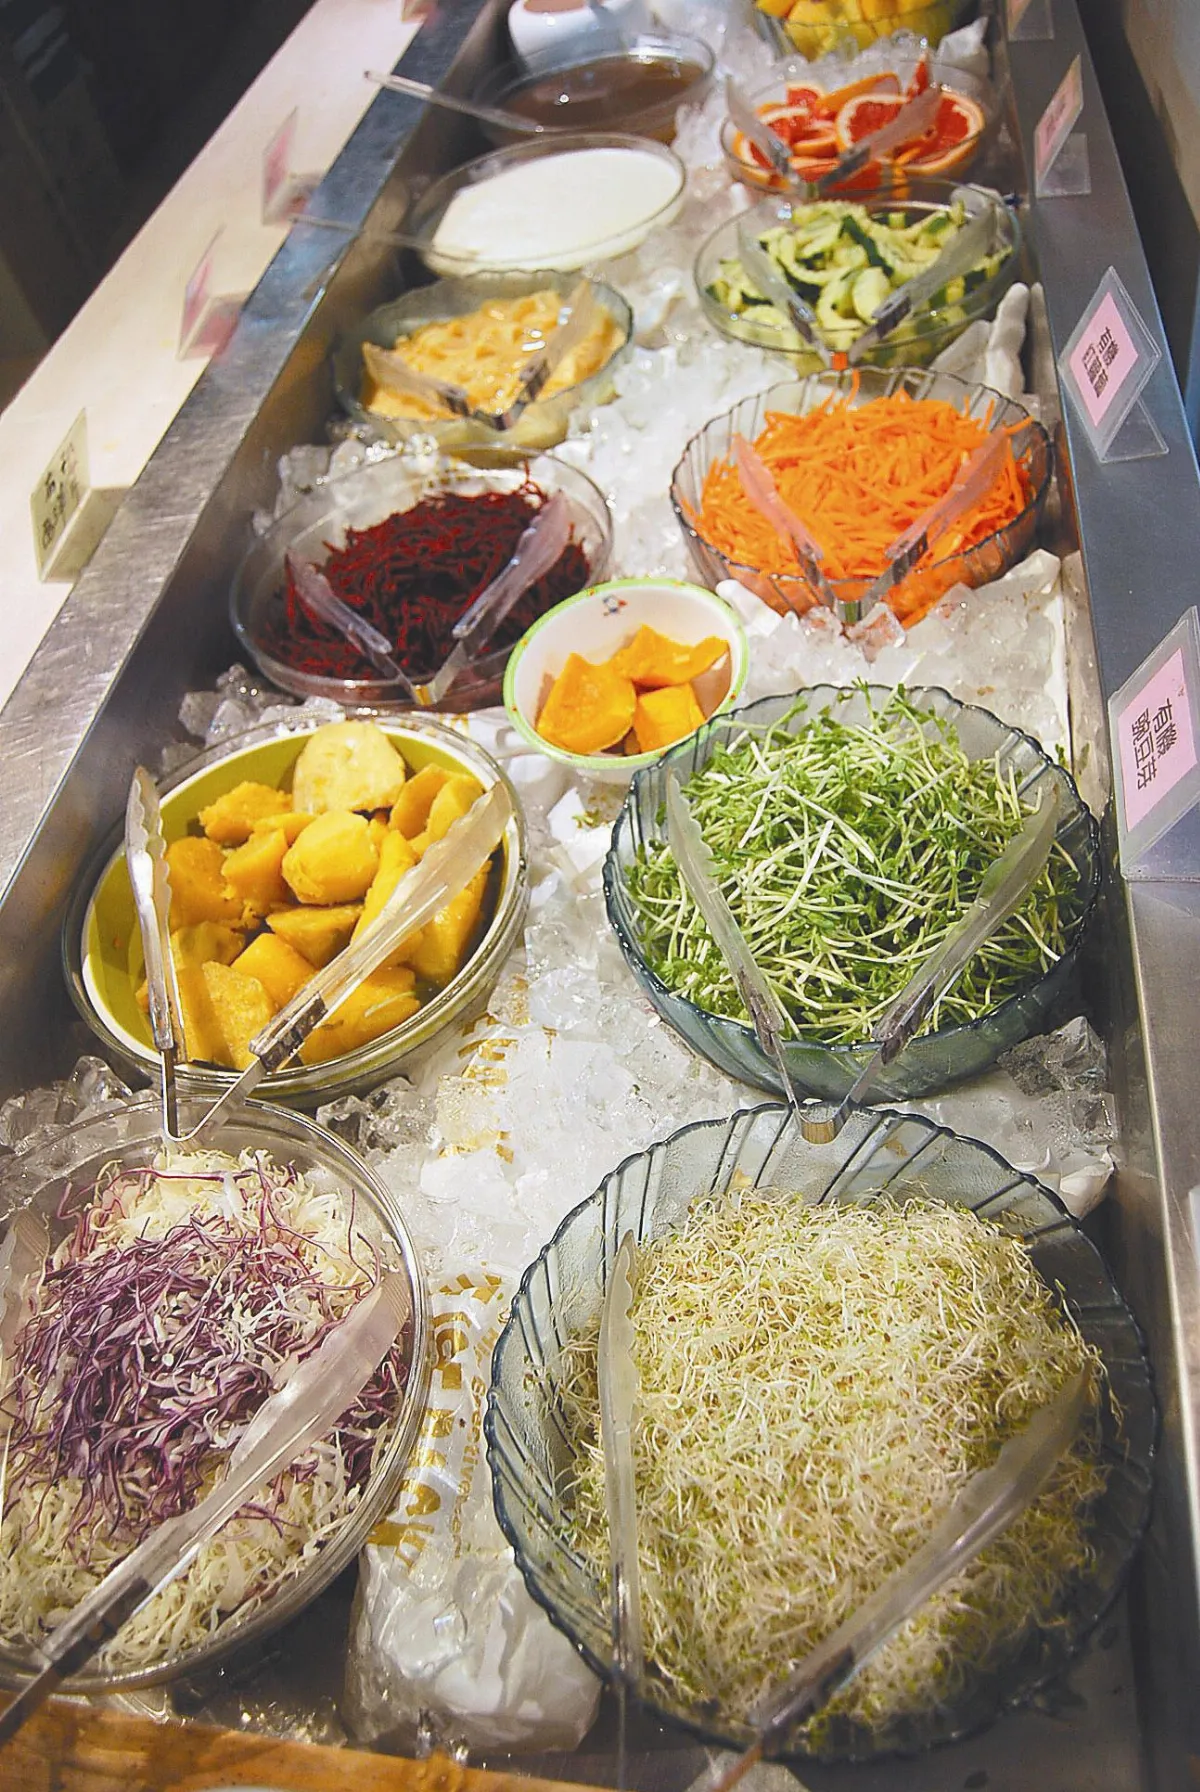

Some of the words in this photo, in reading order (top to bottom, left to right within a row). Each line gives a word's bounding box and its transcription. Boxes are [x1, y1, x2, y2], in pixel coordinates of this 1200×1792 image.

[1131, 707, 1157, 790] 豌豆芽
[1152, 697, 1177, 759] 有機
